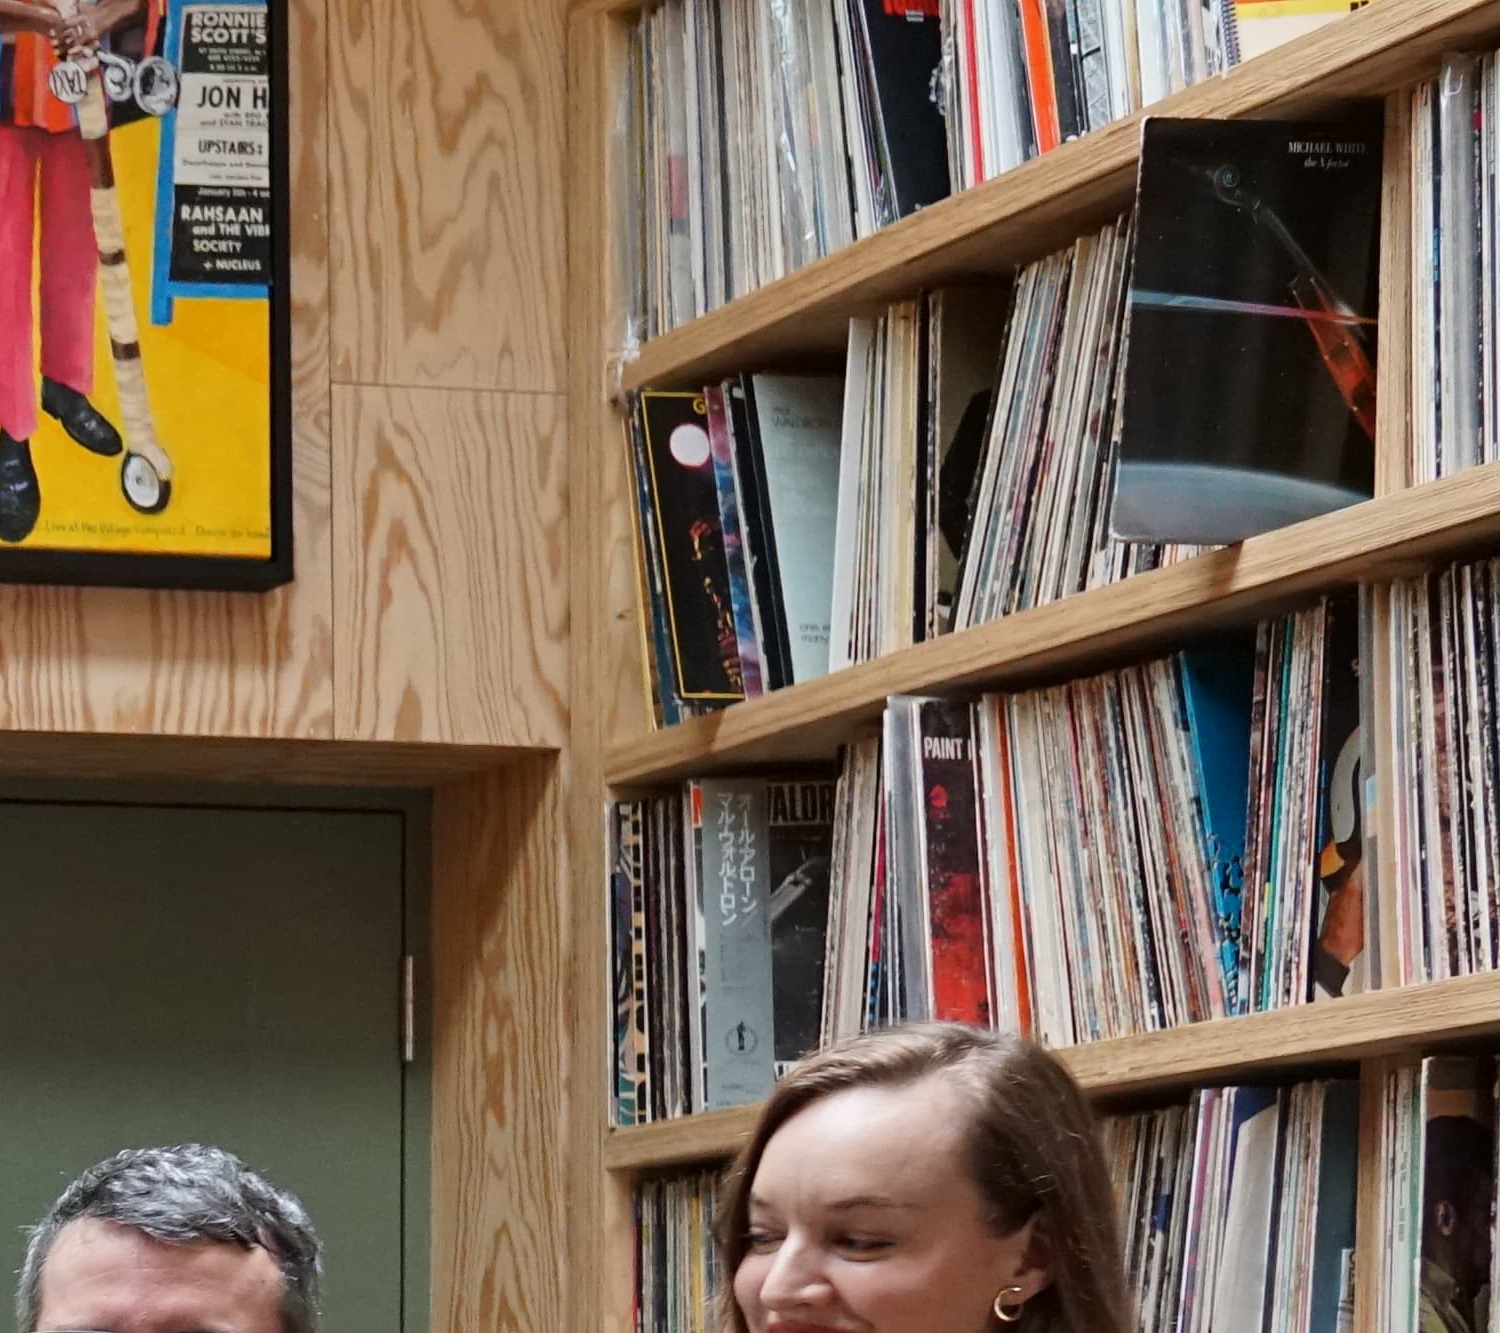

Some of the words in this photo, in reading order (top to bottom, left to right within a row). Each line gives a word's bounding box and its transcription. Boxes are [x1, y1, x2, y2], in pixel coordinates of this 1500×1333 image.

[191, 11, 266, 28] RONNIE
[190, 28, 267, 44] SCOTT'S
[197, 86, 241, 108] JON
[181, 204, 263, 223] RAHSAAN
[192, 224, 216, 236] and
[219, 224, 241, 236] THE
[192, 239, 242, 252] SOCIETY
[215, 259, 262, 271] NUCLEUS
[923, 736, 963, 760] PAINT
